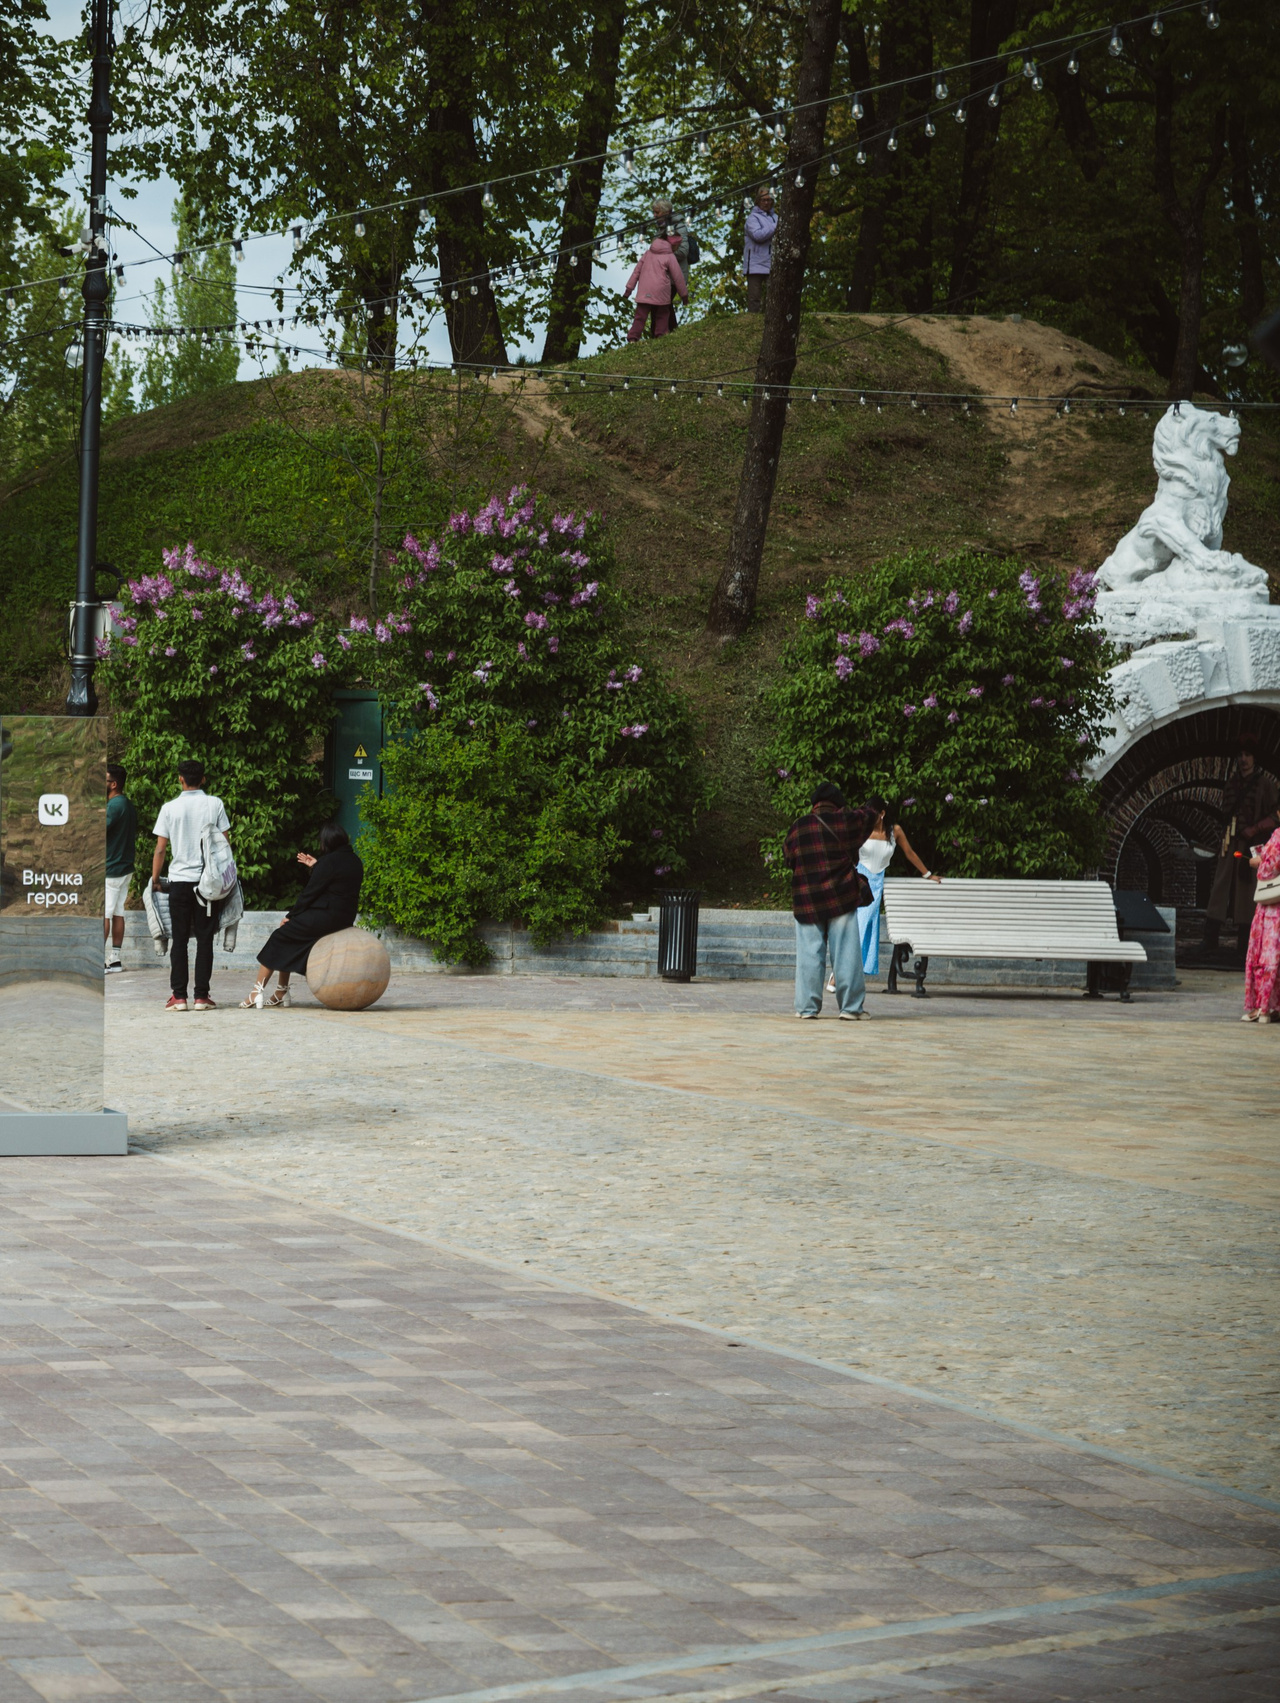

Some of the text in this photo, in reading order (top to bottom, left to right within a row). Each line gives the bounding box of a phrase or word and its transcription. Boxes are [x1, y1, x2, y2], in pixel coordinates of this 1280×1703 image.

[44, 803, 63, 816] VK
[23, 870, 83, 889] Внучка
[27, 892, 78, 908] героя
